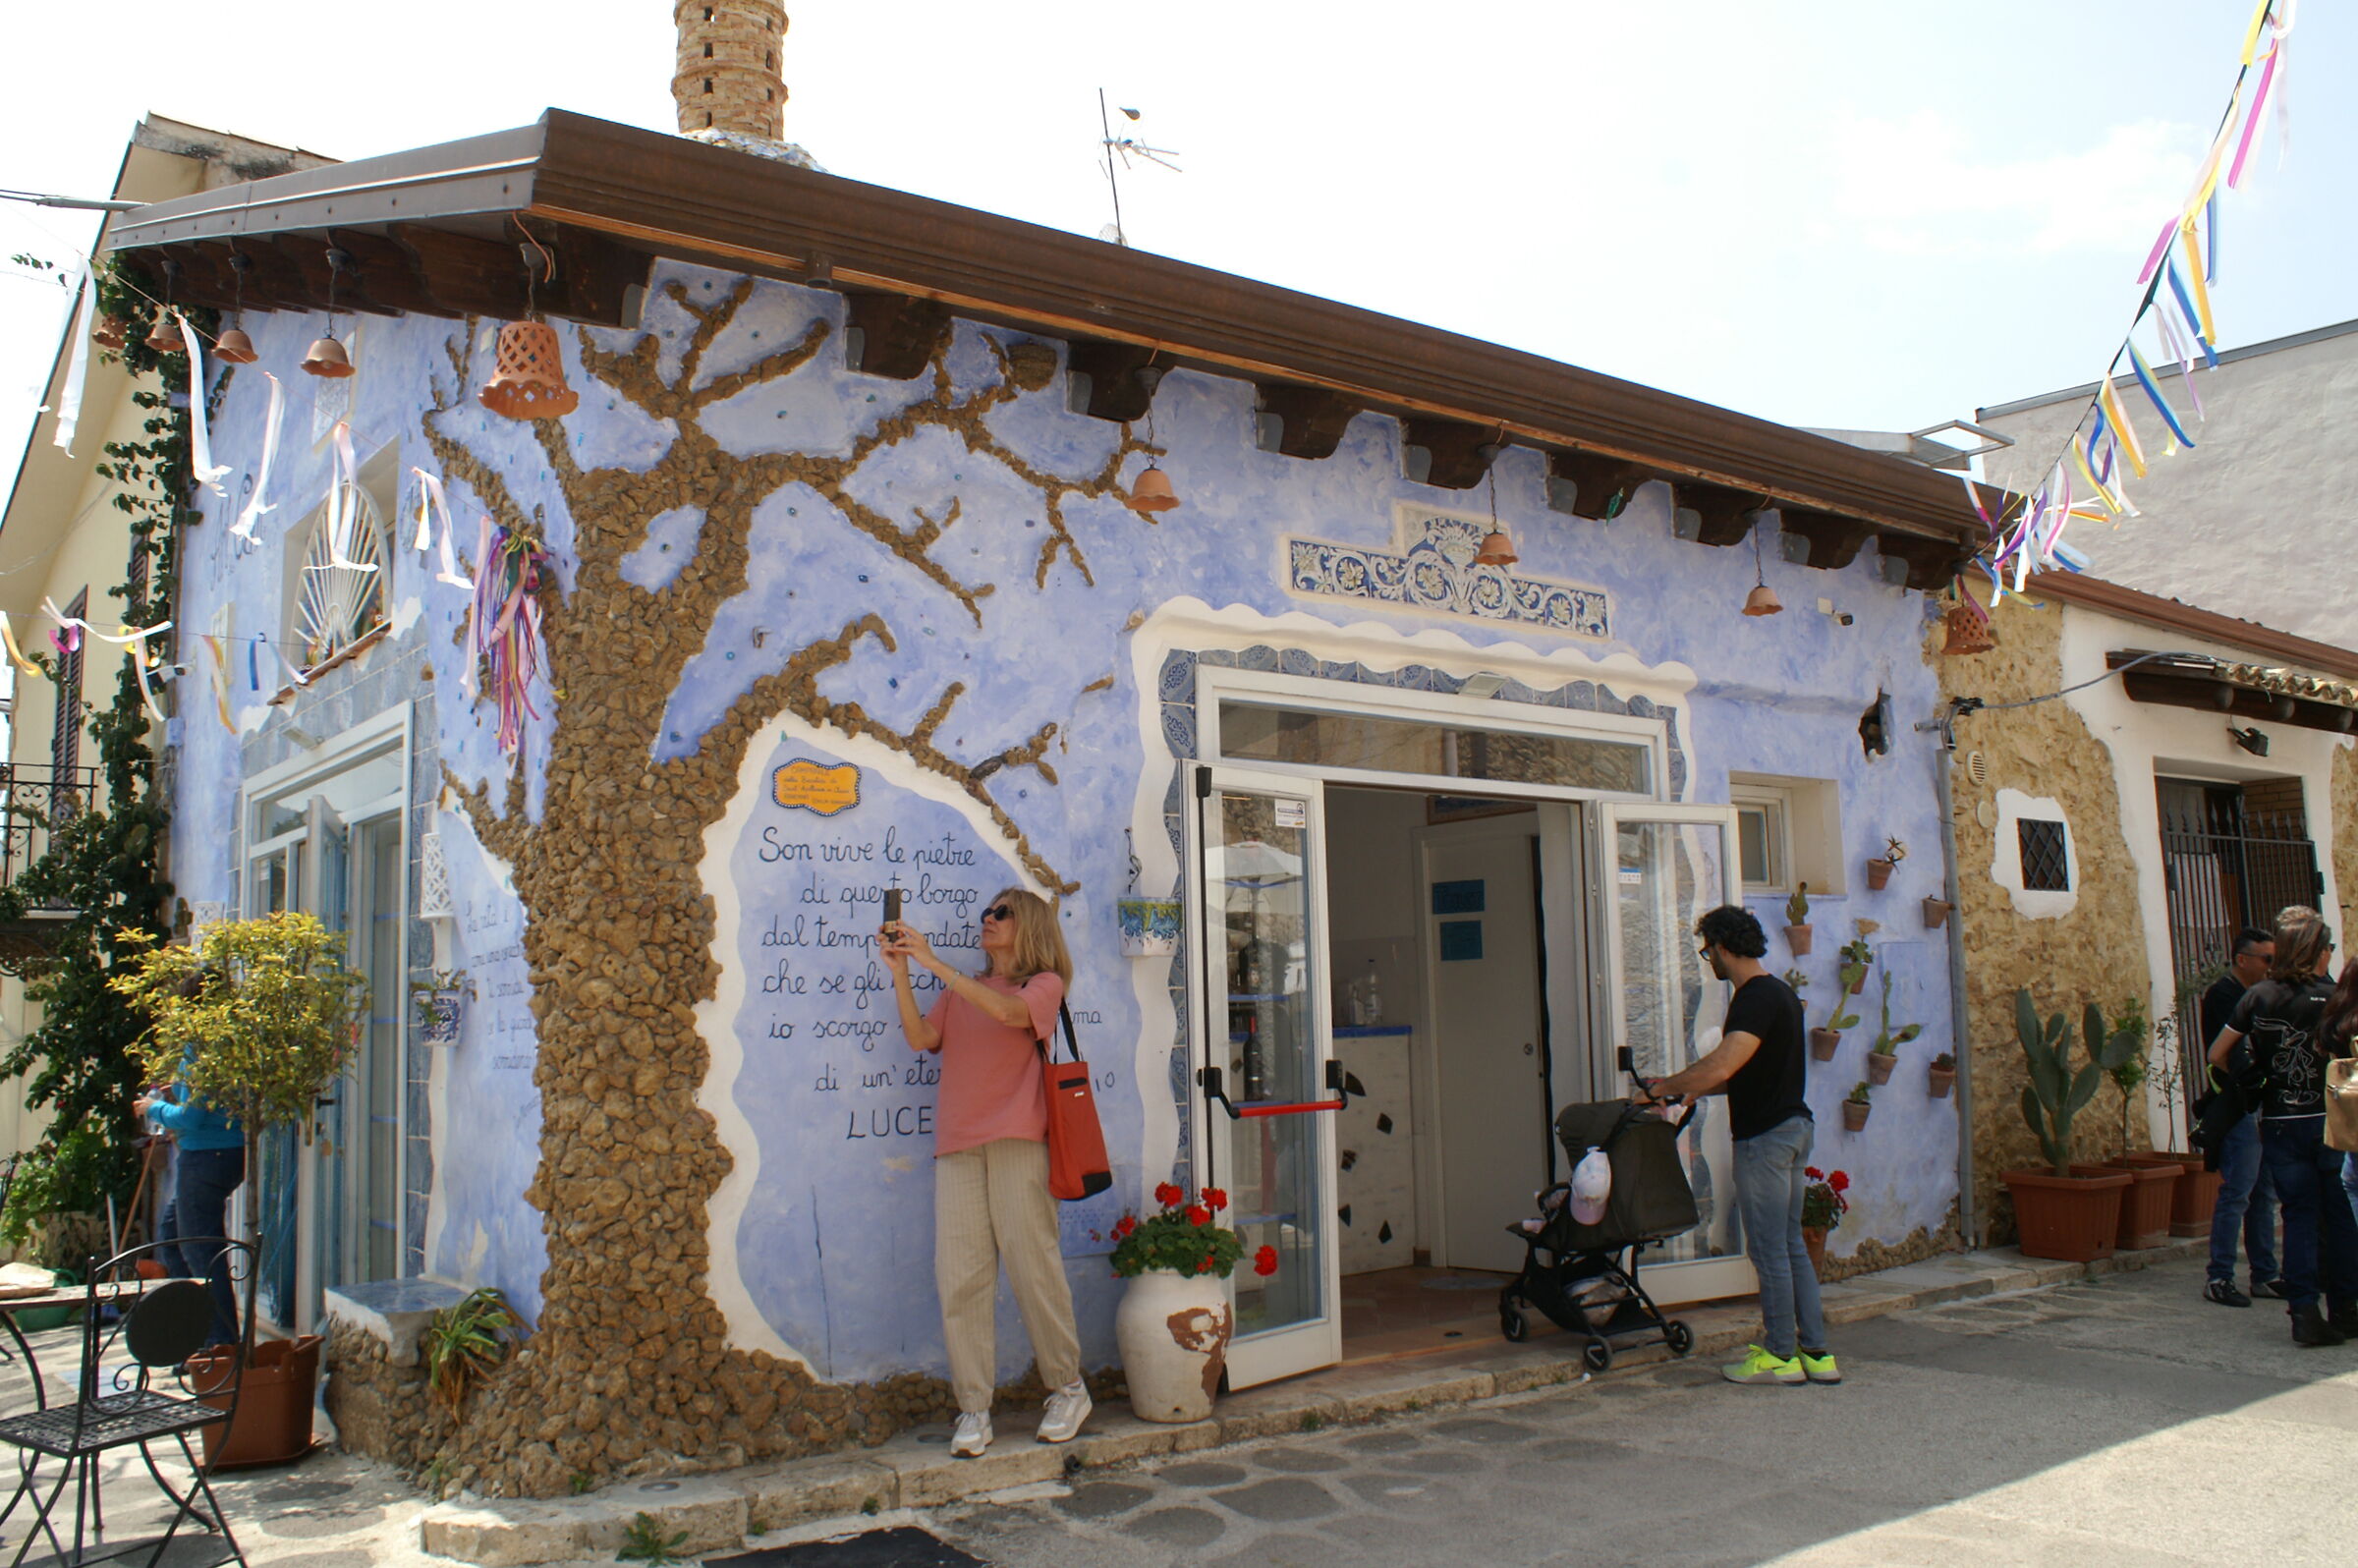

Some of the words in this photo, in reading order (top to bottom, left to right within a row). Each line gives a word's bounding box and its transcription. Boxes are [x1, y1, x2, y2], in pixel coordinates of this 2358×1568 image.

[759, 826, 813, 863] Son
[820, 837, 873, 862] vive
[883, 825, 906, 863] le
[913, 831, 976, 870] pietre
[800, 870, 830, 904] di
[839, 870, 913, 920] queto
[917, 873, 979, 919] borgo
[761, 915, 809, 947] dal
[814, 915, 881, 960] temp
[924, 920, 981, 950] ndate
[761, 958, 808, 994] che
[818, 974, 846, 993] se
[854, 961, 885, 1010] gli
[768, 1013, 795, 1038] io
[813, 1020, 888, 1052] scorgo
[814, 1062, 839, 1092] di
[846, 1106, 932, 1140] LUCE
